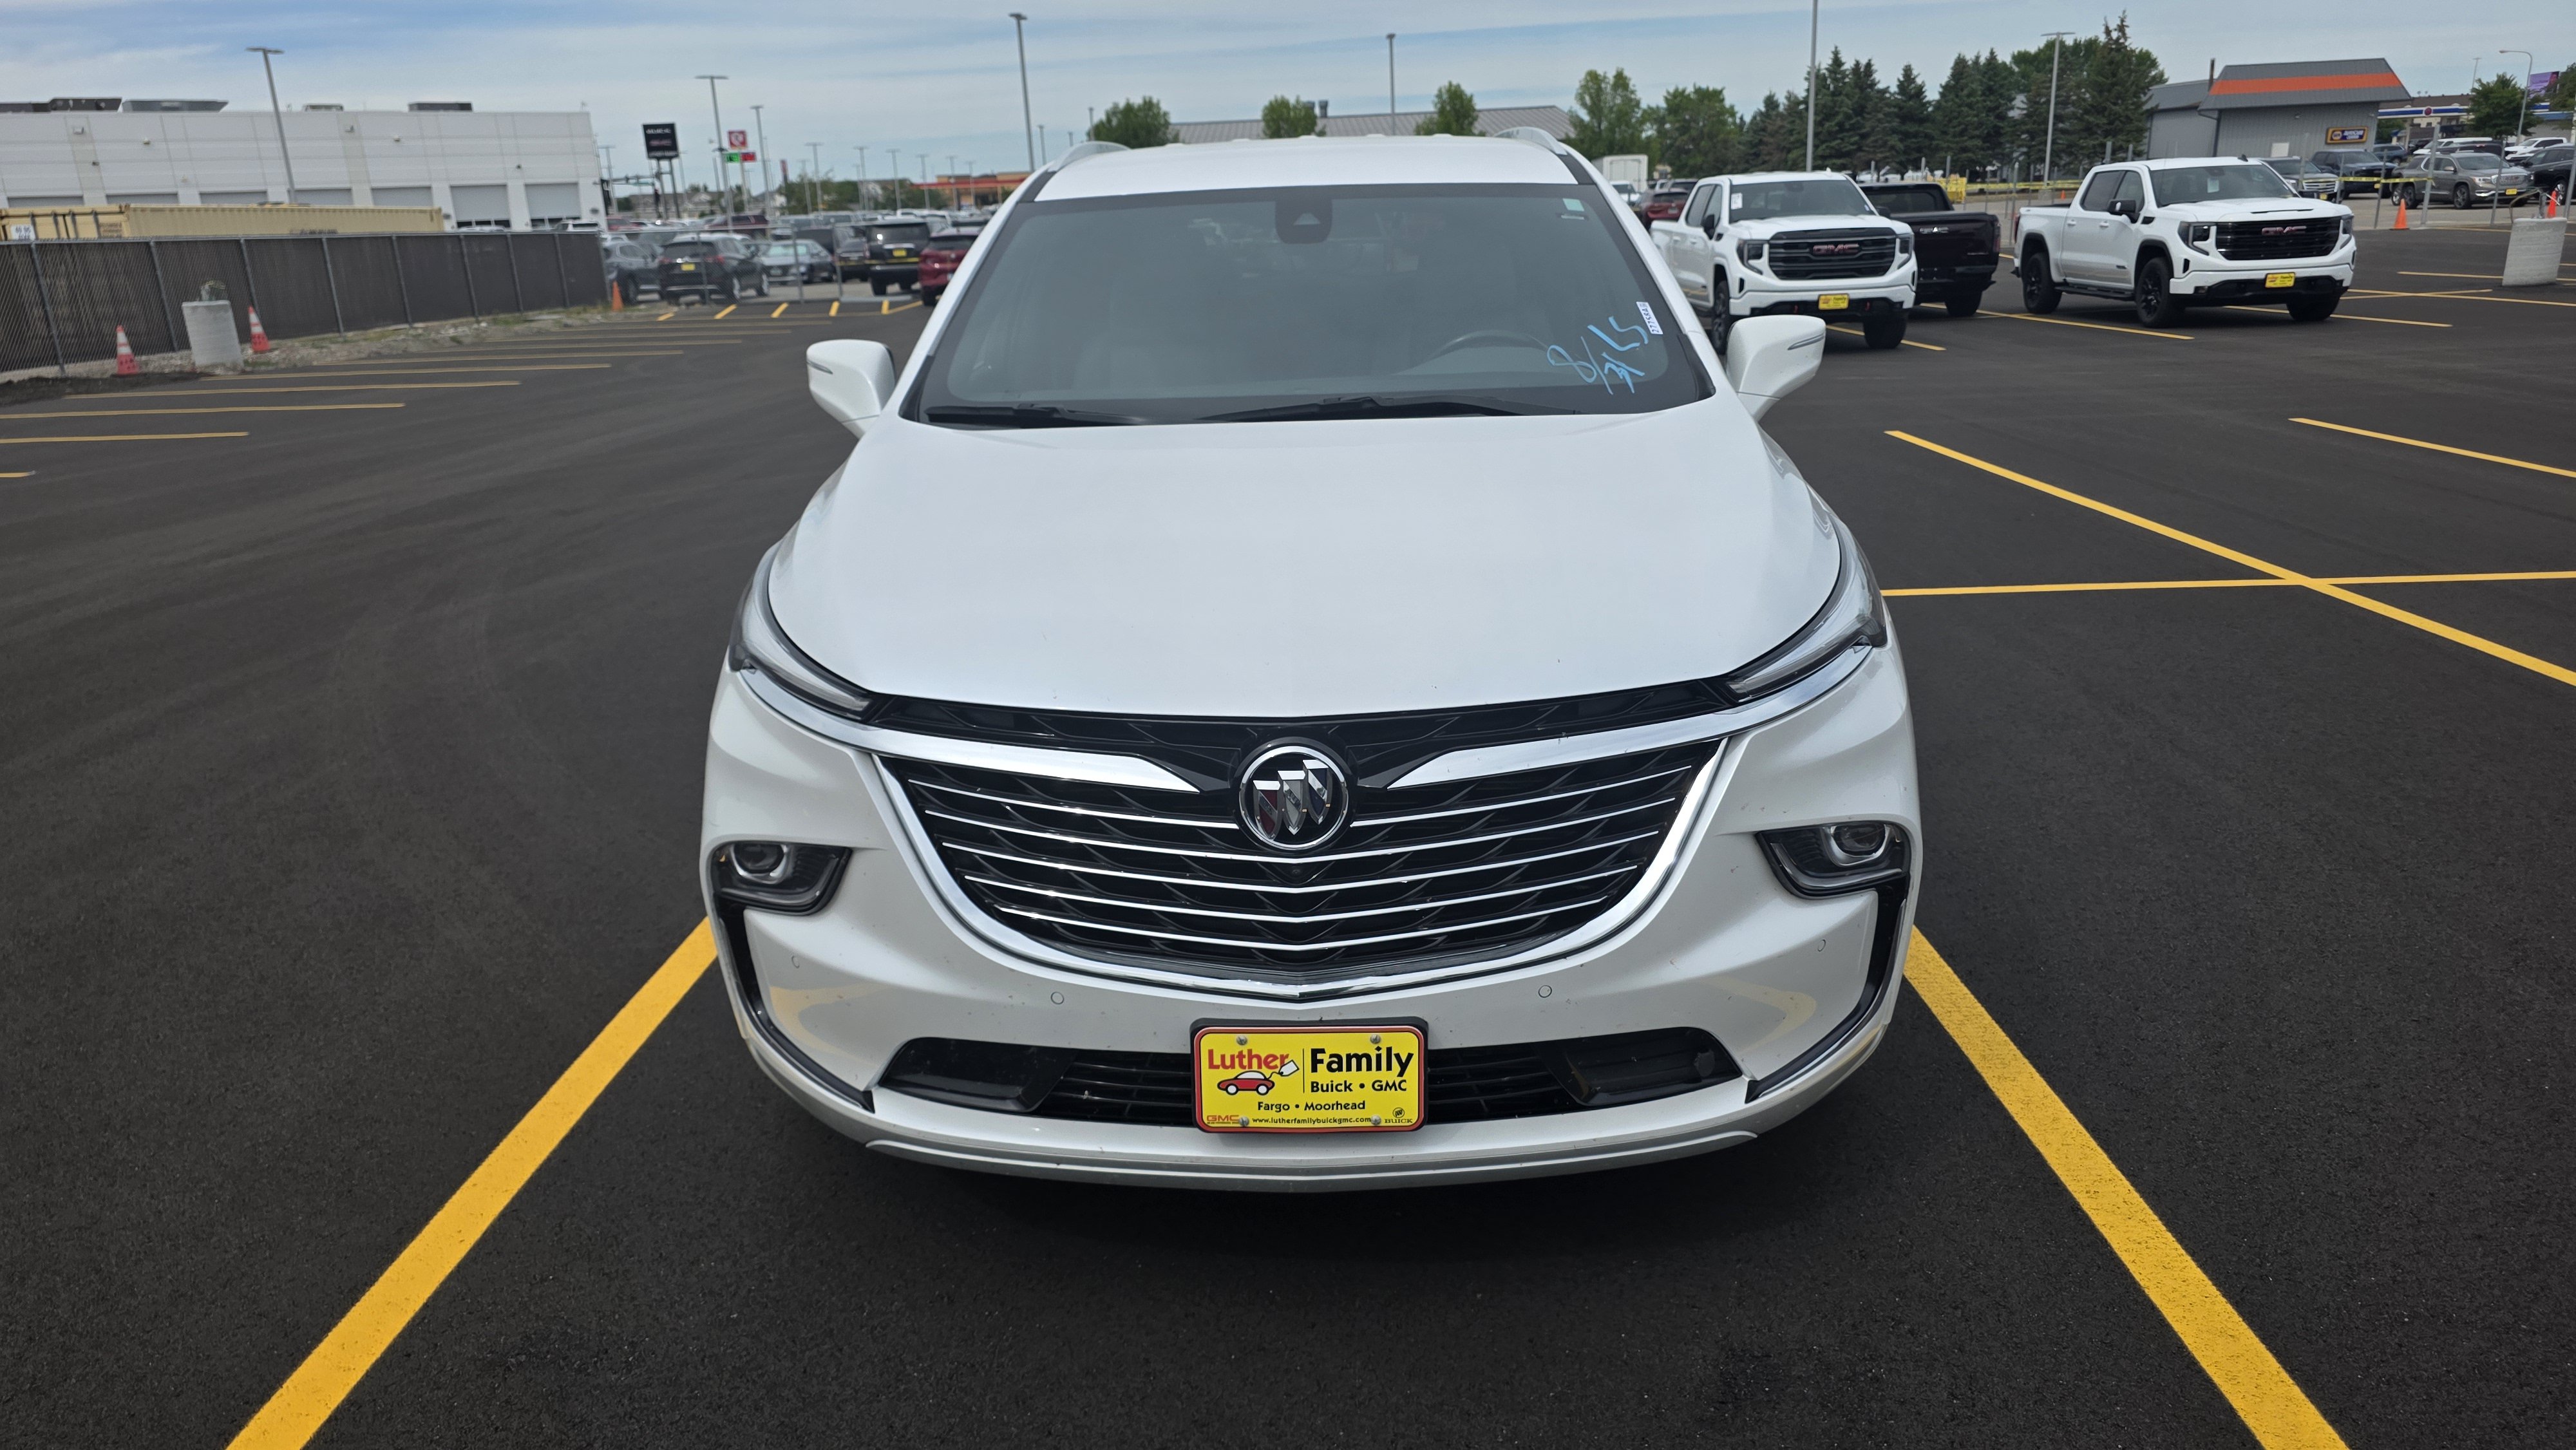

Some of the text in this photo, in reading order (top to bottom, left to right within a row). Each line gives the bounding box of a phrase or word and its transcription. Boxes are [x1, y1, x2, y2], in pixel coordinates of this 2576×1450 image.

[2262, 225, 2307, 236] GMC
[1813, 243, 1860, 255] GMC
[1208, 1046, 1414, 1077] Luther Family
[1311, 1079, 1407, 1093] Buick GMC
[1258, 1100, 1366, 1113] Fargo Moorhead
[1252, 1116, 1372, 1125] www.lutherfamilybuickgmc.com
